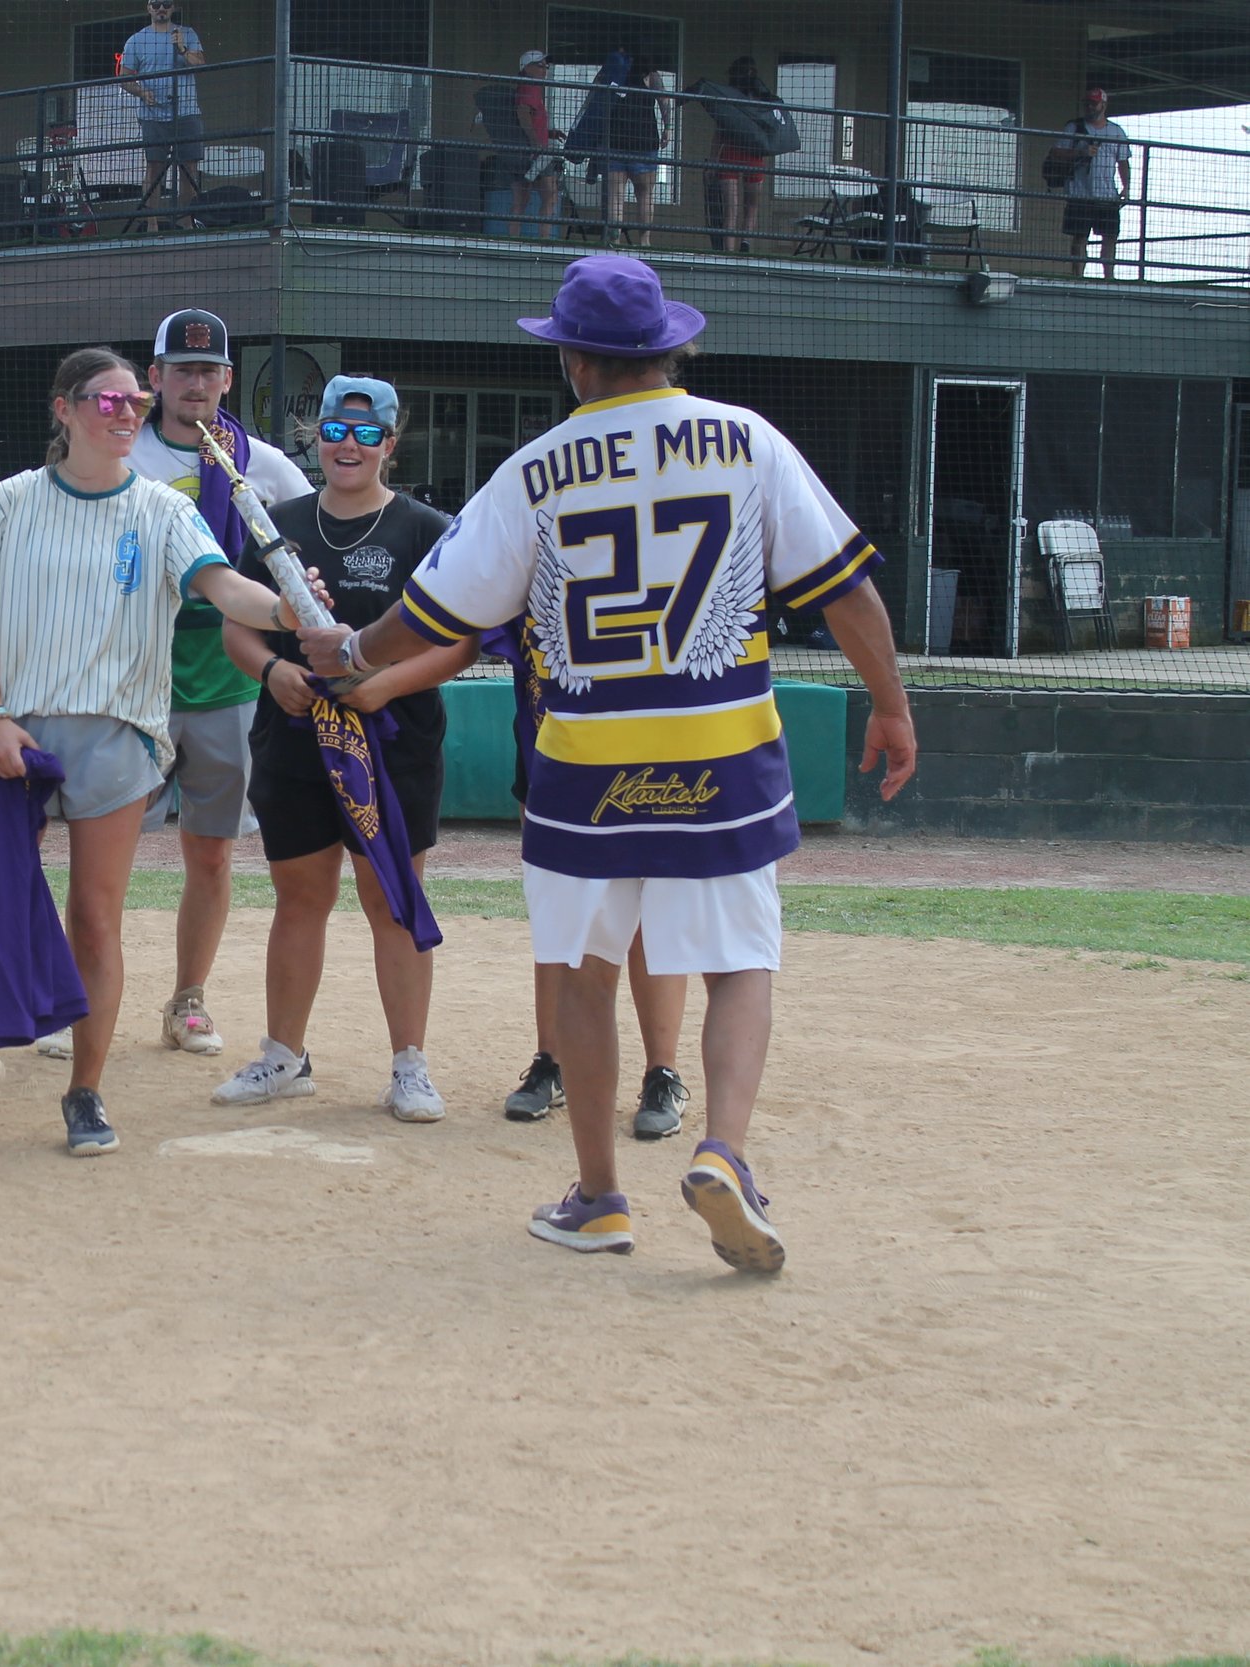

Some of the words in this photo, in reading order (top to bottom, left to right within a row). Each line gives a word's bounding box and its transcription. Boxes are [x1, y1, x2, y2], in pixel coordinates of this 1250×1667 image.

[521, 430, 639, 510] DUDE
[654, 417, 754, 477] MAN
[558, 492, 732, 668] 27
